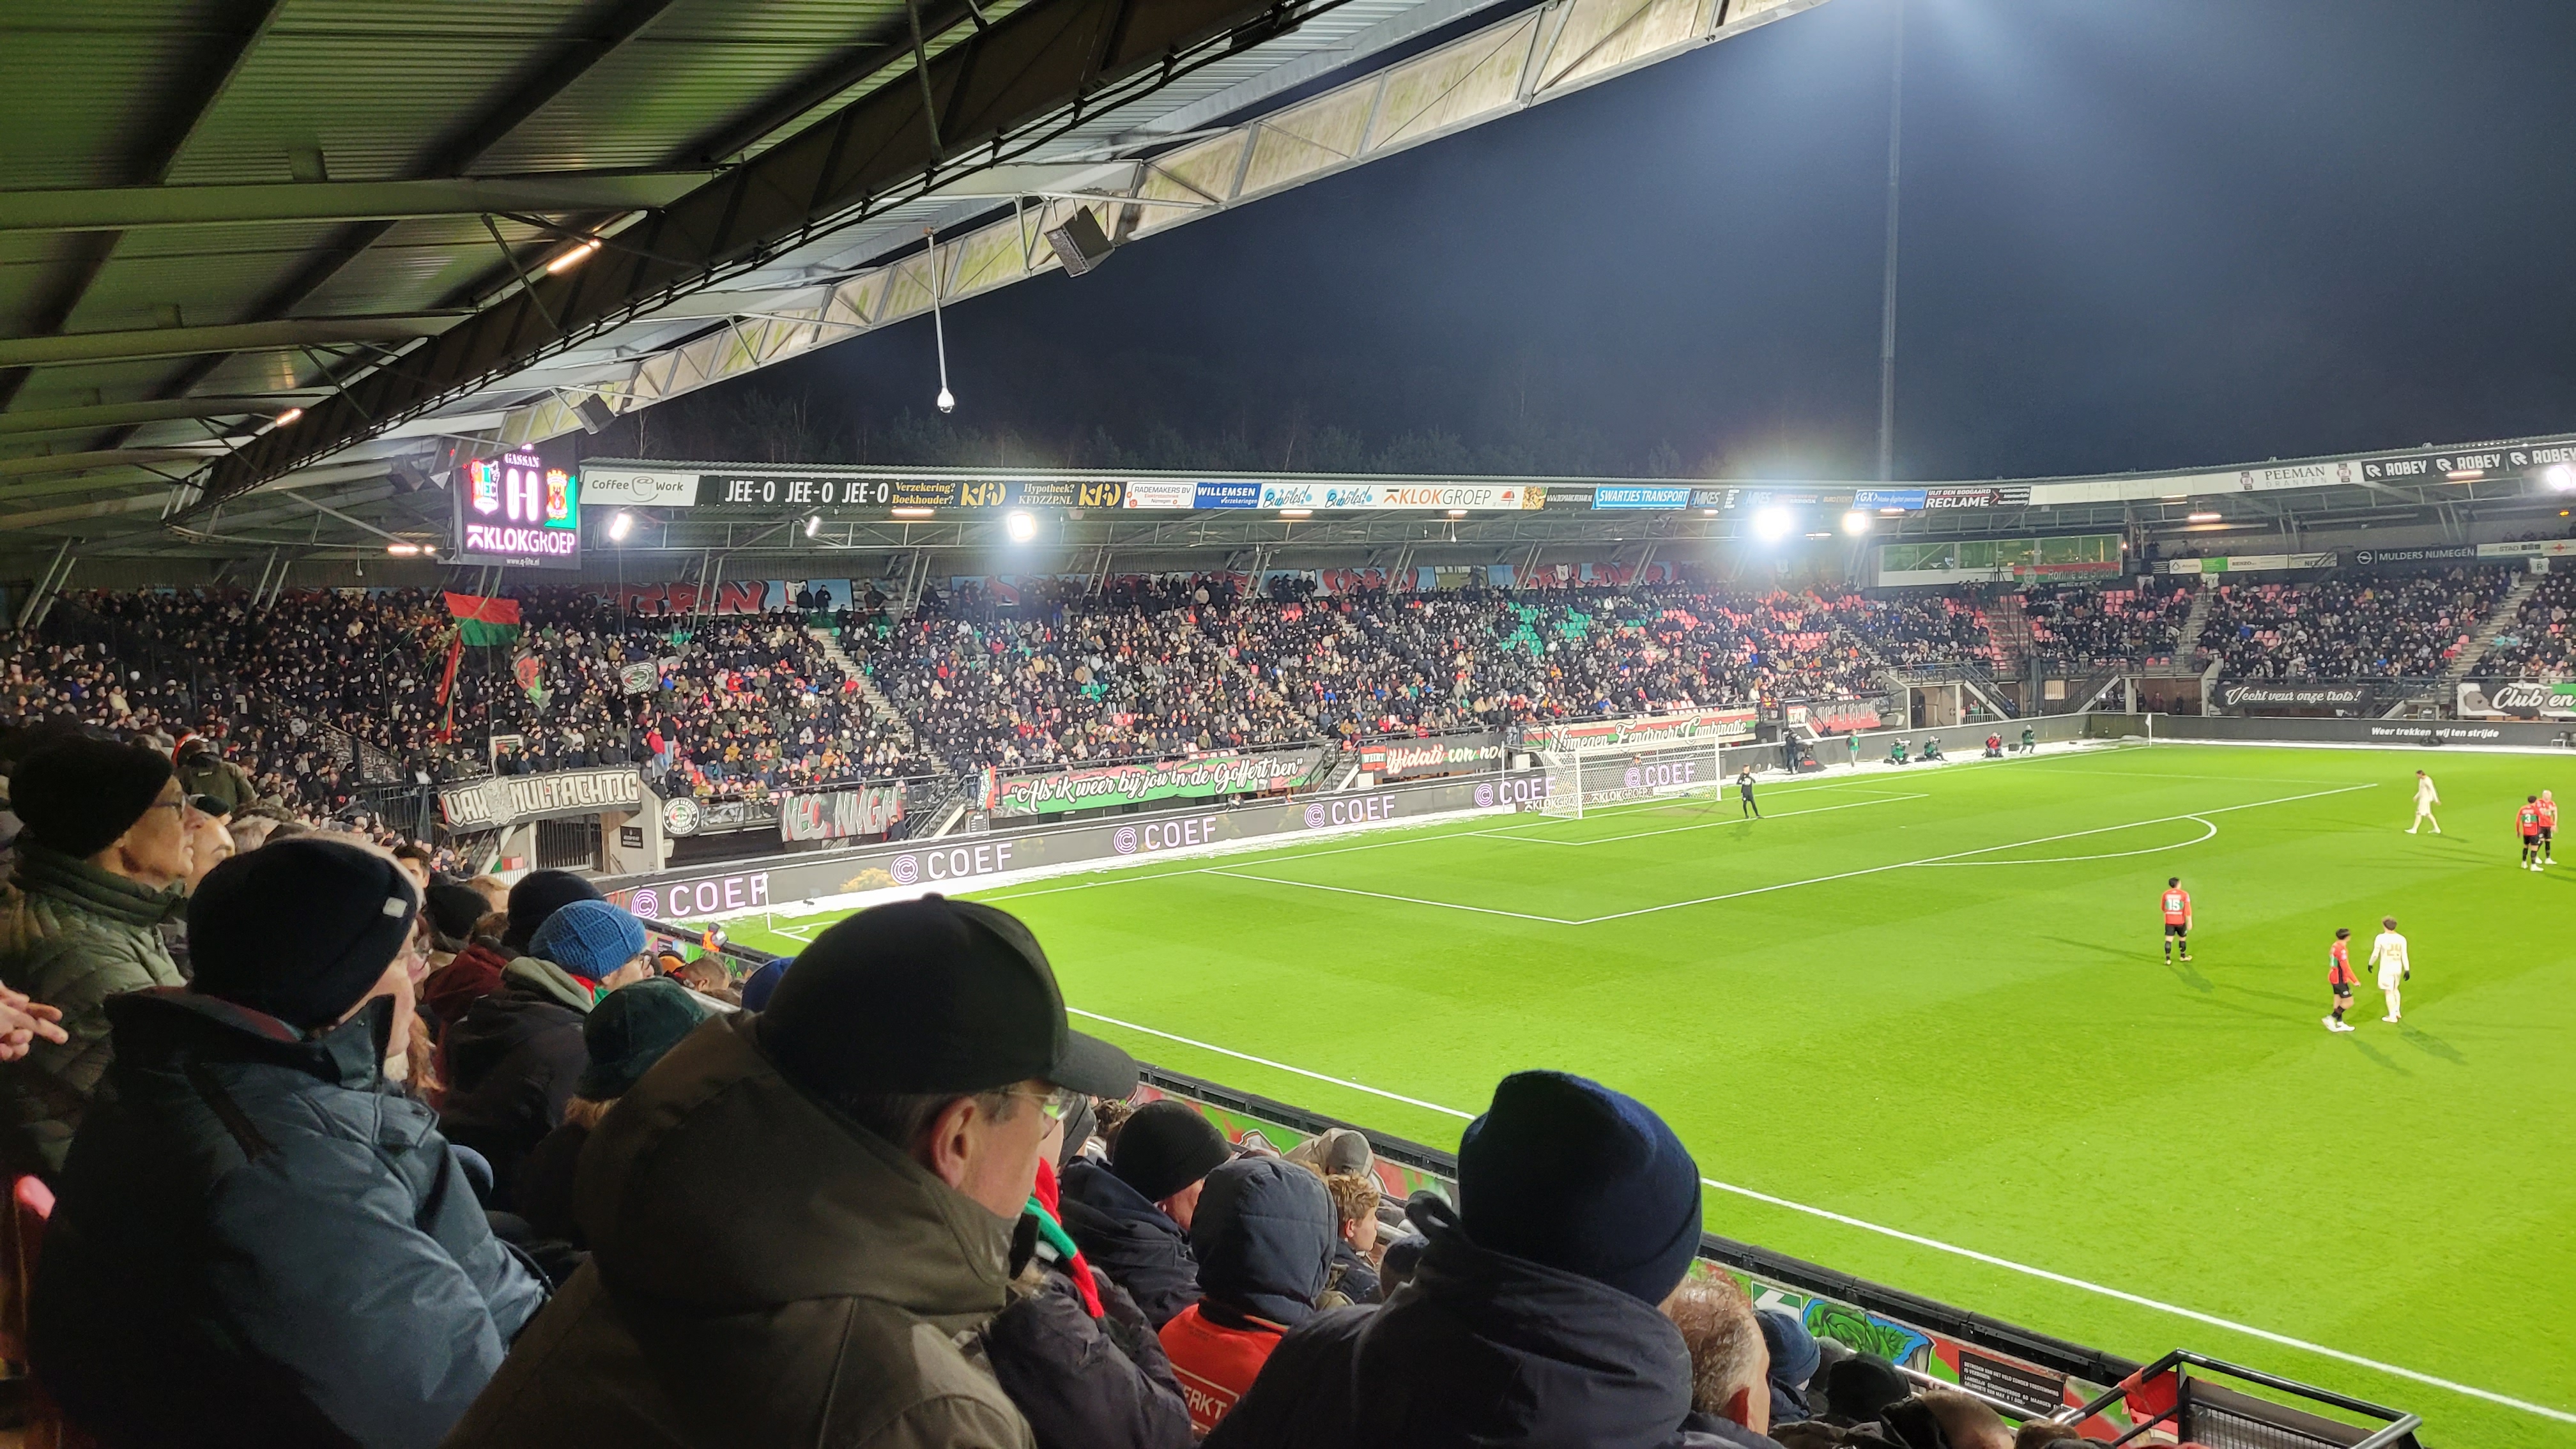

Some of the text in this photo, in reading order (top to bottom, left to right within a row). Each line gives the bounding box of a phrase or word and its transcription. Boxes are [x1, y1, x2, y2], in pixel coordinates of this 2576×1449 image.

[504, 452, 540, 468] GASSAN
[2385, 459, 2428, 477] ROBEY
[2456, 453, 2501, 470] ROBEY
[2264, 466, 2326, 480] PEEMAN
[592, 479, 629, 491] Coffee
[656, 481, 684, 491] Work
[895, 482, 956, 493] Verzekering?
[1023, 483, 1075, 494] Hypotheek?
[2266, 477, 2327, 488] DRANKEN
[1197, 486, 1255, 496] WILLEMSEN
[1400, 488, 1491, 505] KLOKGROEP
[1599, 489, 1689, 503] SWARTJES TRANSPORT
[891, 494, 954, 505] Boekhouder?
[1220, 496, 1258, 505] Verzekeringen
[1926, 496, 1990, 509] RECLAME
[483, 526, 576, 555] KLOKGROEP
[2379, 551, 2424, 561] MULDERS
[2425, 548, 2474, 559] NIJMEGEN
[2048, 569, 2076, 580] Ronnie
[2078, 569, 2088, 579] de
[2225, 686, 2268, 705] Vecht
[2296, 692, 2325, 704] onze
[2492, 686, 2576, 710] Club en
[2372, 727, 2500, 739] Weer trekken wij ten strijde
[1448, 747, 1476, 763] con
[1055, 775, 1077, 803] ik
[1076, 776, 1116, 797] weer
[1118, 769, 1141, 799] bij
[1138, 770, 1170, 797] jou
[1170, 766, 1189, 787] in
[1190, 763, 1211, 786] de
[1213, 758, 1271, 794] Goffert
[1645, 762, 1695, 786] COEF
[446, 770, 640, 825] VAK NULTACHTIG
[1499, 776, 1556, 804] COEF
[1331, 795, 1395, 825] COEF
[2525, 813, 2531, 824] 3
[1144, 816, 1217, 851] COEF
[928, 842, 1013, 880] COEF
[670, 874, 766, 917] COEF
[2168, 898, 2181, 911] 15
[2002, 1373, 2012, 1382] VELD
[1183, 1384, 1228, 1420] ERKT
